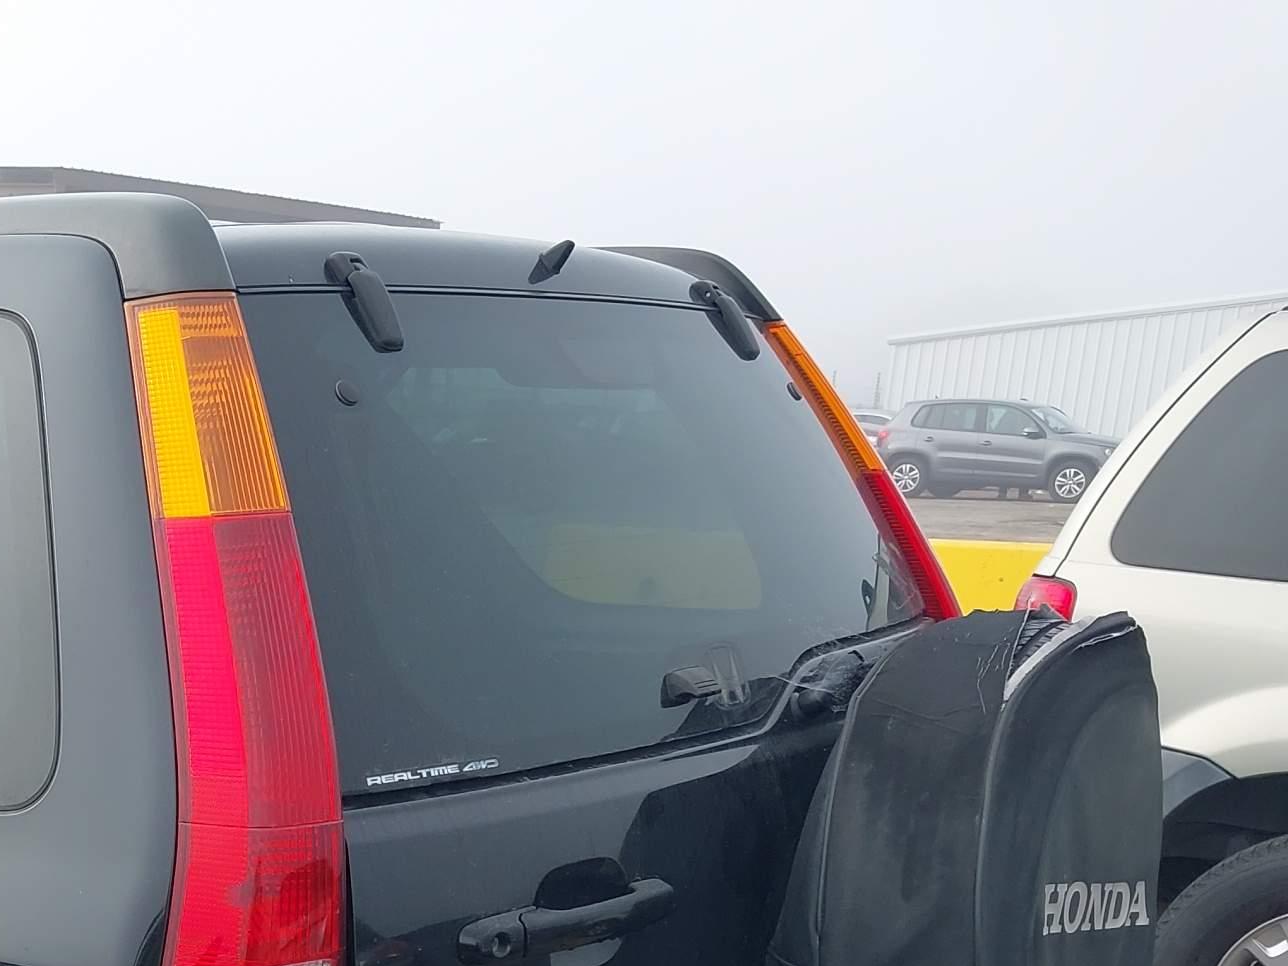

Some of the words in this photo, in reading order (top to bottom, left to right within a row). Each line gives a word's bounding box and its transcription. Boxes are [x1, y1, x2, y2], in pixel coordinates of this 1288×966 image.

[366, 763, 461, 787] REALTIME
[462, 758, 500, 773] 4WD
[1042, 880, 1150, 936] HONDA
